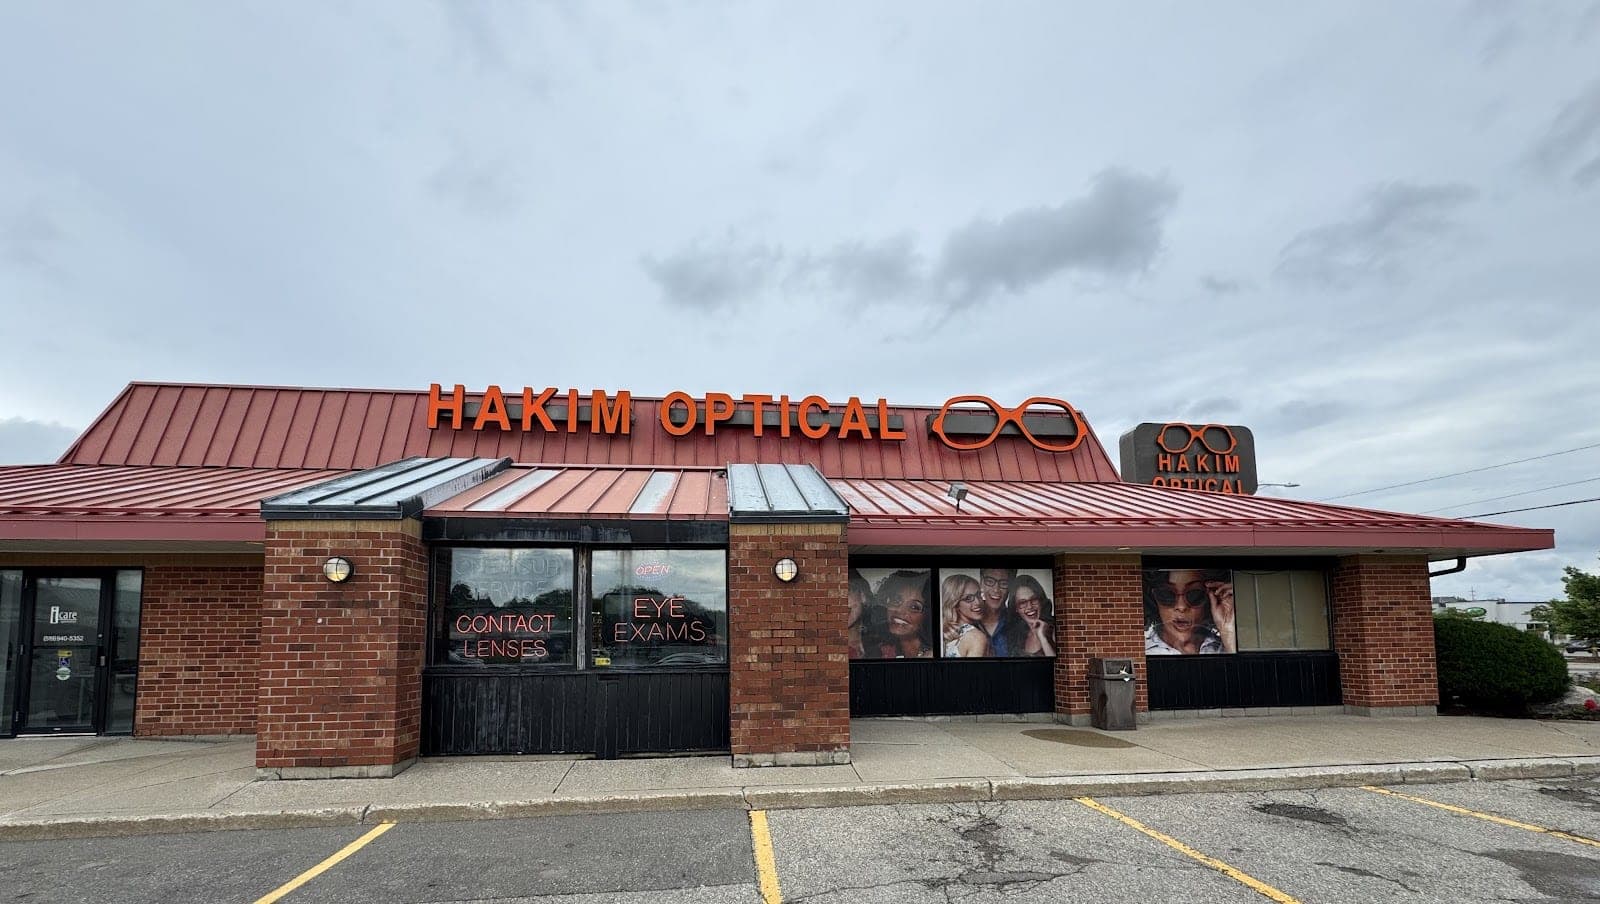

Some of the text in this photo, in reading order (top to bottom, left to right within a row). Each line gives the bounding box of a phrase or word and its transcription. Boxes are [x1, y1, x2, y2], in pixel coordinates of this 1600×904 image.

[427, 383, 907, 440] HAKIM OPTICAL
[1158, 453, 1240, 473] HAKIM
[635, 564, 670, 576] OPEN
[634, 597, 685, 618] EYE
[456, 614, 556, 633] CONTACT
[614, 620, 706, 642] EXAMS
[464, 639, 548, 657] LENSES
